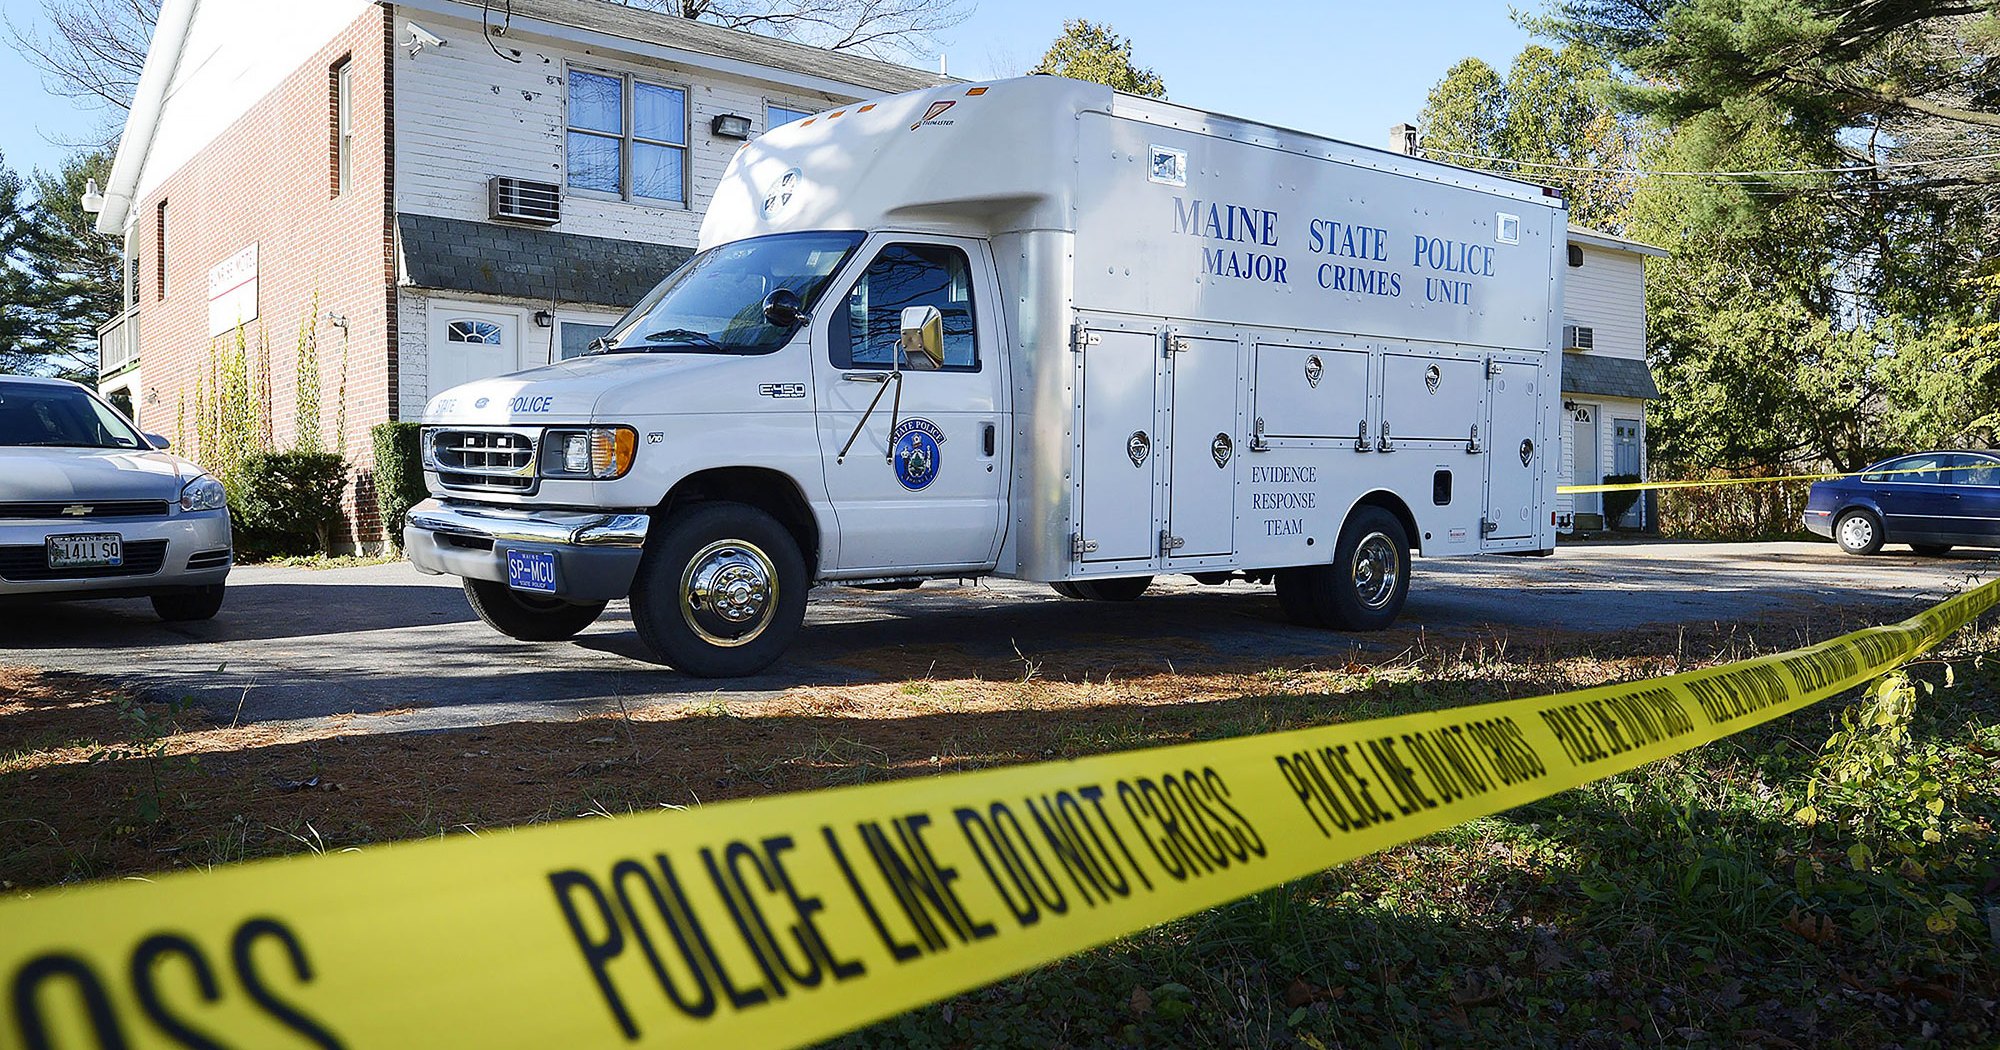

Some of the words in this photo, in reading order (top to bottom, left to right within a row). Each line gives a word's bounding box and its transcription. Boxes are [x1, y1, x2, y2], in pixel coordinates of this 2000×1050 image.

[1172, 196, 1278, 247] MAINE
[1309, 218, 1388, 262] STATE
[1413, 235, 1496, 277] POLICE
[1201, 247, 1287, 284] MAJOR
[1317, 263, 1401, 297] CRIMES
[1425, 277, 1472, 305] UNIT
[506, 396, 553, 413] POLICE
[915, 421, 943, 442] POLICE
[1252, 466, 1317, 483] EVIDENCE
[1252, 492, 1316, 510] RESPONSE
[65, 543, 96, 559] 1411
[102, 542, 118, 558] SQ
[1263, 518, 1303, 536] TEAM
[510, 558, 554, 583] SP-MCU
[1354, 736, 1439, 817] LINE
[1401, 731, 1464, 805] DO
[1428, 724, 1498, 798] NOT
[1465, 715, 1547, 788] CROSS
[1274, 744, 1395, 840] POLICE
[546, 835, 867, 1043] POLICE
[819, 811, 999, 963] LINE
[952, 801, 1070, 929] DO
[1024, 784, 1154, 908] NOT
[1115, 766, 1268, 882] CROSS
